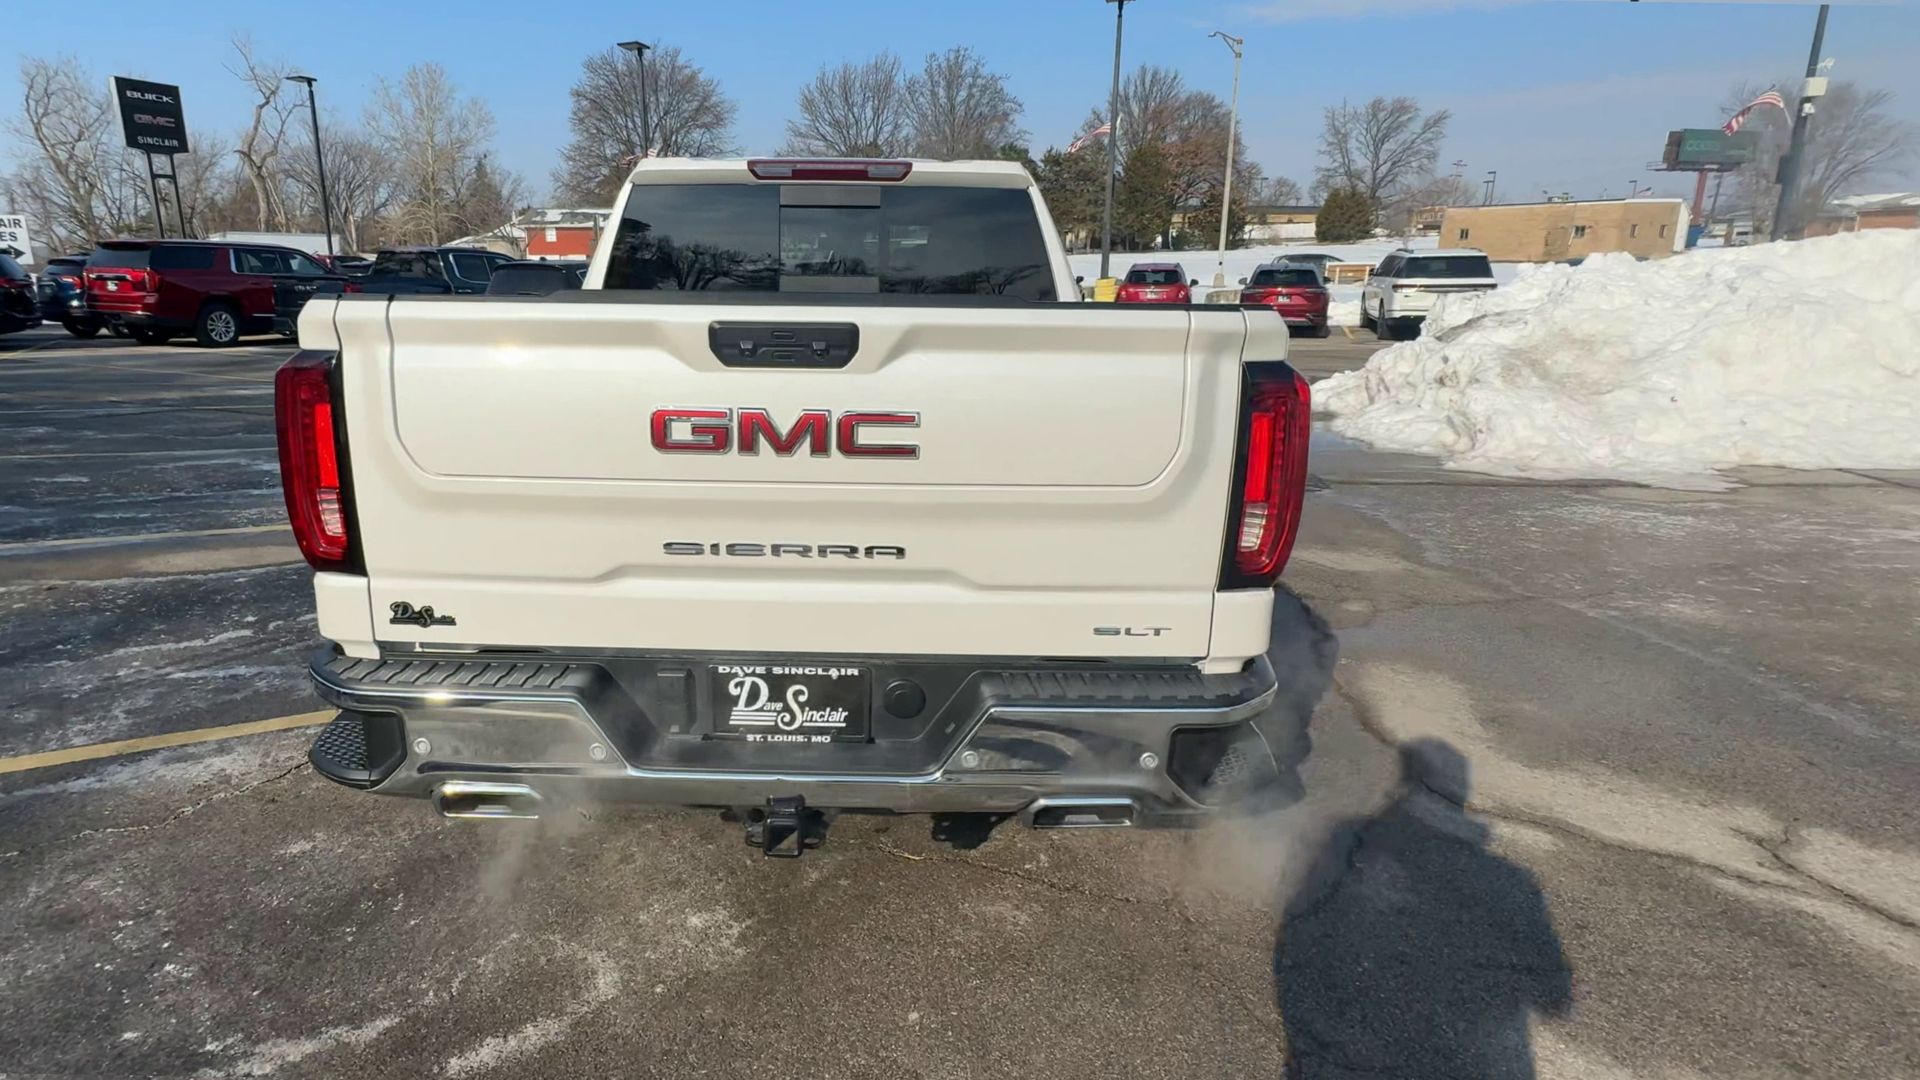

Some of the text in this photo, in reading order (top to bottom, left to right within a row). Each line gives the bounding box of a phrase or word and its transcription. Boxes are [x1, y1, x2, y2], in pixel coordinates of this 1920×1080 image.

[126, 90, 175, 104] BUICK
[133, 114, 176, 127] GMC
[137, 135, 179, 147] SINCLAIR
[650, 404, 921, 460] GMC
[662, 541, 907, 560] SIERRA
[1093, 626, 1172, 637] SLT
[718, 666, 860, 677] DAVE SINCLAIR
[728, 676, 849, 731] Dave Sinclair
[746, 734, 764, 742] ST.
[811, 735, 831, 743] MO
